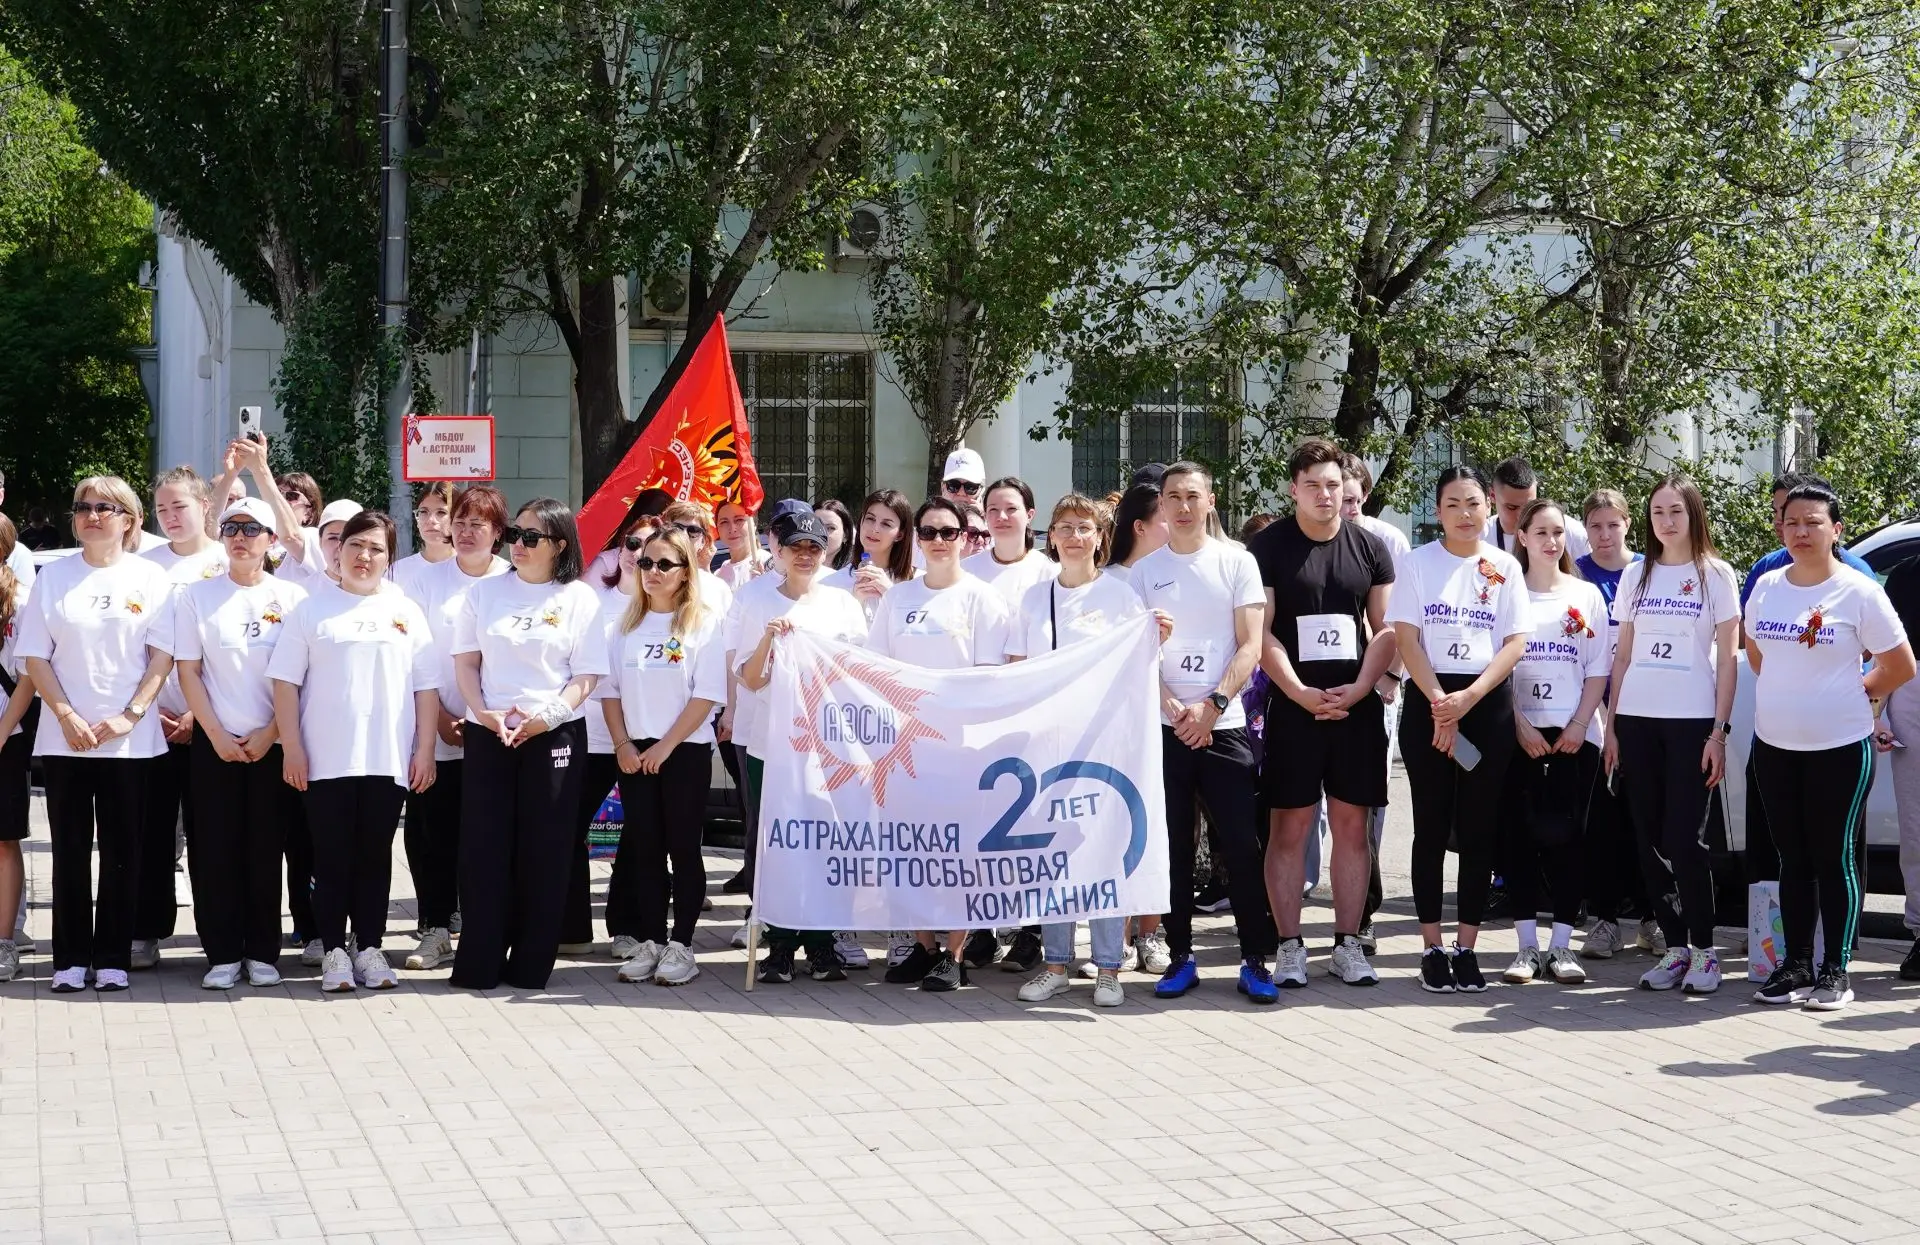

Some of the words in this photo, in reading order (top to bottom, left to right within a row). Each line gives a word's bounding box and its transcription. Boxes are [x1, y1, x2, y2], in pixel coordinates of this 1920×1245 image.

[434, 432, 464, 442] МБДОУ
[430, 445, 476, 453] АСТРАХАНИ
[449, 457, 461, 465] 111
[88, 595, 111, 610] 73
[1424, 603, 1459, 617] УФСИН
[511, 615, 533, 631] 73
[905, 610, 929, 625] 67
[240, 621, 261, 637] 73
[353, 621, 379, 633] 73
[1317, 629, 1342, 647] 42
[644, 643, 664, 659] 73
[1447, 643, 1471, 660] 42
[1651, 642, 1672, 660] 42
[1180, 655, 1205, 672] 42
[1532, 683, 1552, 700] 42
[1047, 793, 1100, 823] ЛЕТ
[978, 757, 1148, 880] 20
[768, 818, 960, 853] АСТРАХАНСКАЯ
[826, 850, 1069, 887] ЭНЕРГОСБЫТОВАЯ
[965, 878, 1118, 922] КОМПАНИЯ
